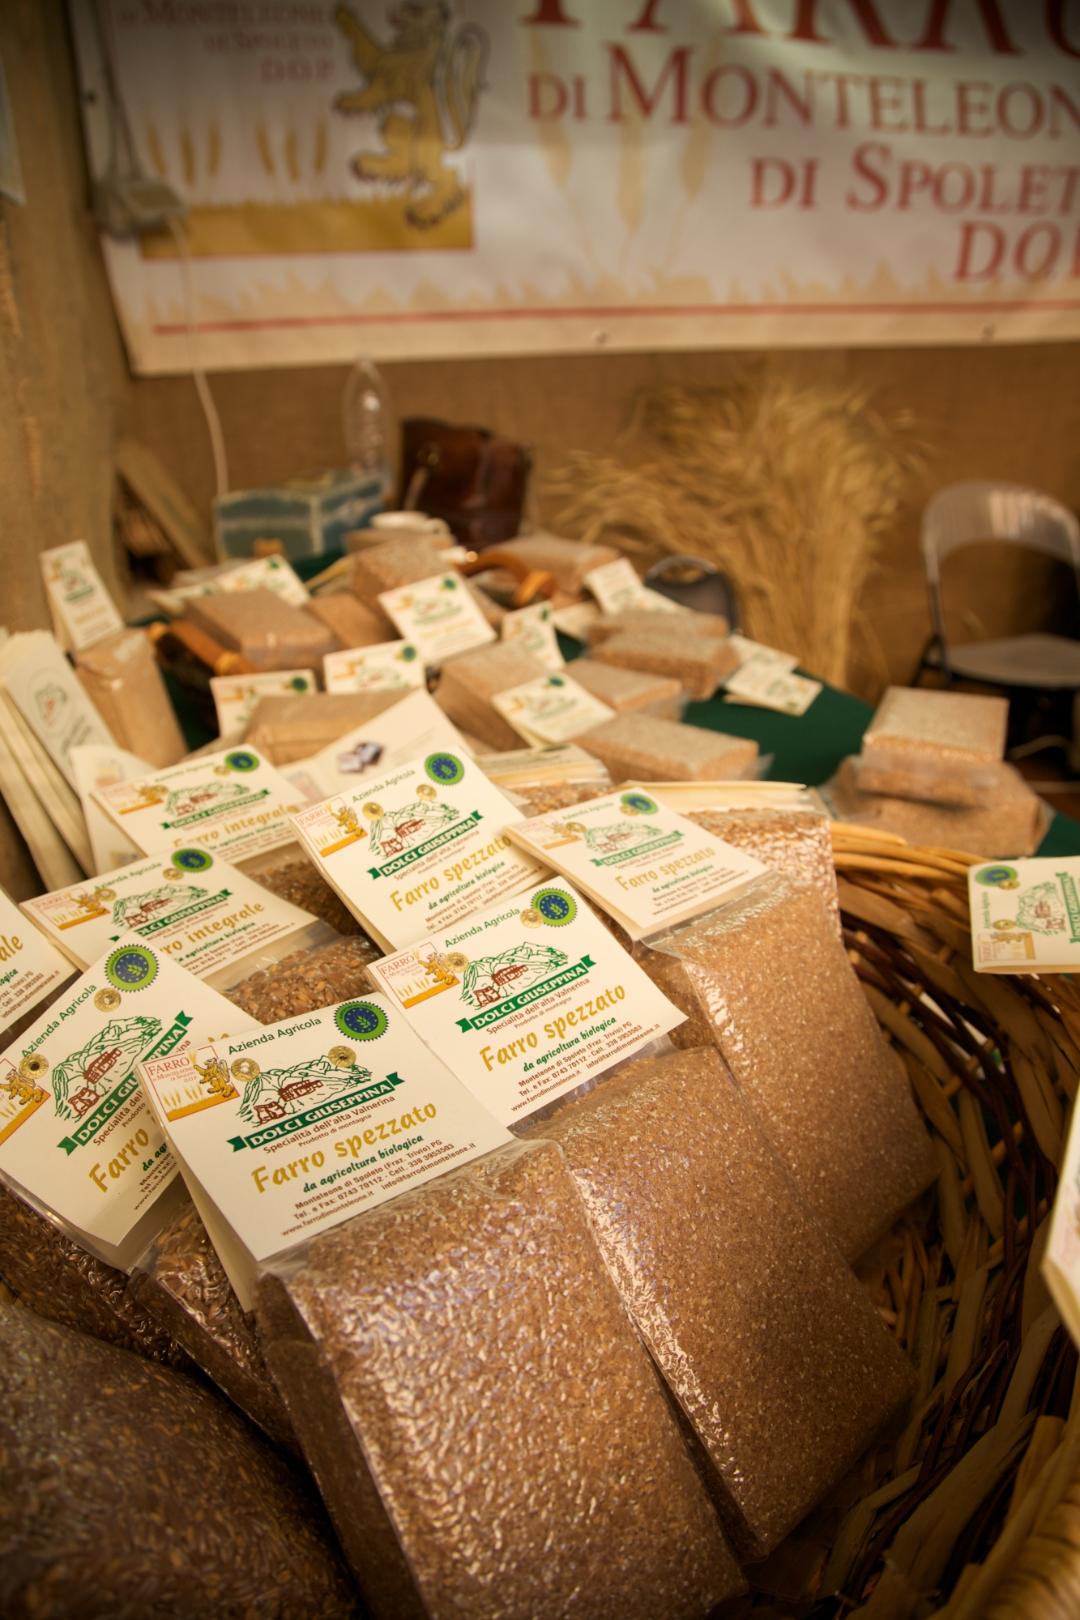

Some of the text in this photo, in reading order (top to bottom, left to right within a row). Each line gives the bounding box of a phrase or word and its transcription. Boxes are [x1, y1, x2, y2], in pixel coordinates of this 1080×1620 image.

[749, 156, 818, 211] DI
[953, 219, 1080, 282] DO
[382, 851, 418, 874] DOLCI
[390, 877, 440, 912] Farro
[443, 835, 512, 882] spezzato
[615, 870, 659, 891] Farro
[659, 847, 716, 876] spezzato
[184, 902, 264, 944] integrale
[445, 926, 484, 948] Azienda
[484, 908, 521, 930] Agricola
[21, 1019, 60, 1057] Azienda
[58, 984, 97, 1021] Agricola
[474, 966, 586, 1028] DOLCI GIUSEPPINA
[228, 1017, 322, 1055] Azienda Agricola
[479, 985, 626, 1072] Farro spezzato
[523, 1016, 617, 1072] da agricoltura biologica
[149, 1057, 190, 1076] FARRO
[77, 1099, 119, 1142] DOLCI
[93, 1108, 131, 1146] Specialità
[250, 1083, 392, 1146] DOLCI GIUSEPPINA
[263, 1095, 396, 1154] Specialità dell'alta Valnerina
[299, 1131, 329, 1147] Prodotto
[89, 1128, 149, 1193] Farro
[142, 1158, 155, 1172] da
[251, 1103, 437, 1194] Farro spezzato
[295, 1187, 344, 1210] Monteleone
[344, 1179, 352, 1188] di
[353, 1167, 384, 1184] Spoleto
[431, 1139, 443, 1149] PG
[303, 1135, 424, 1194] da agricoltura biologica
[293, 1210, 308, 1221] Tel.
[337, 1187, 359, 1201] 0743
